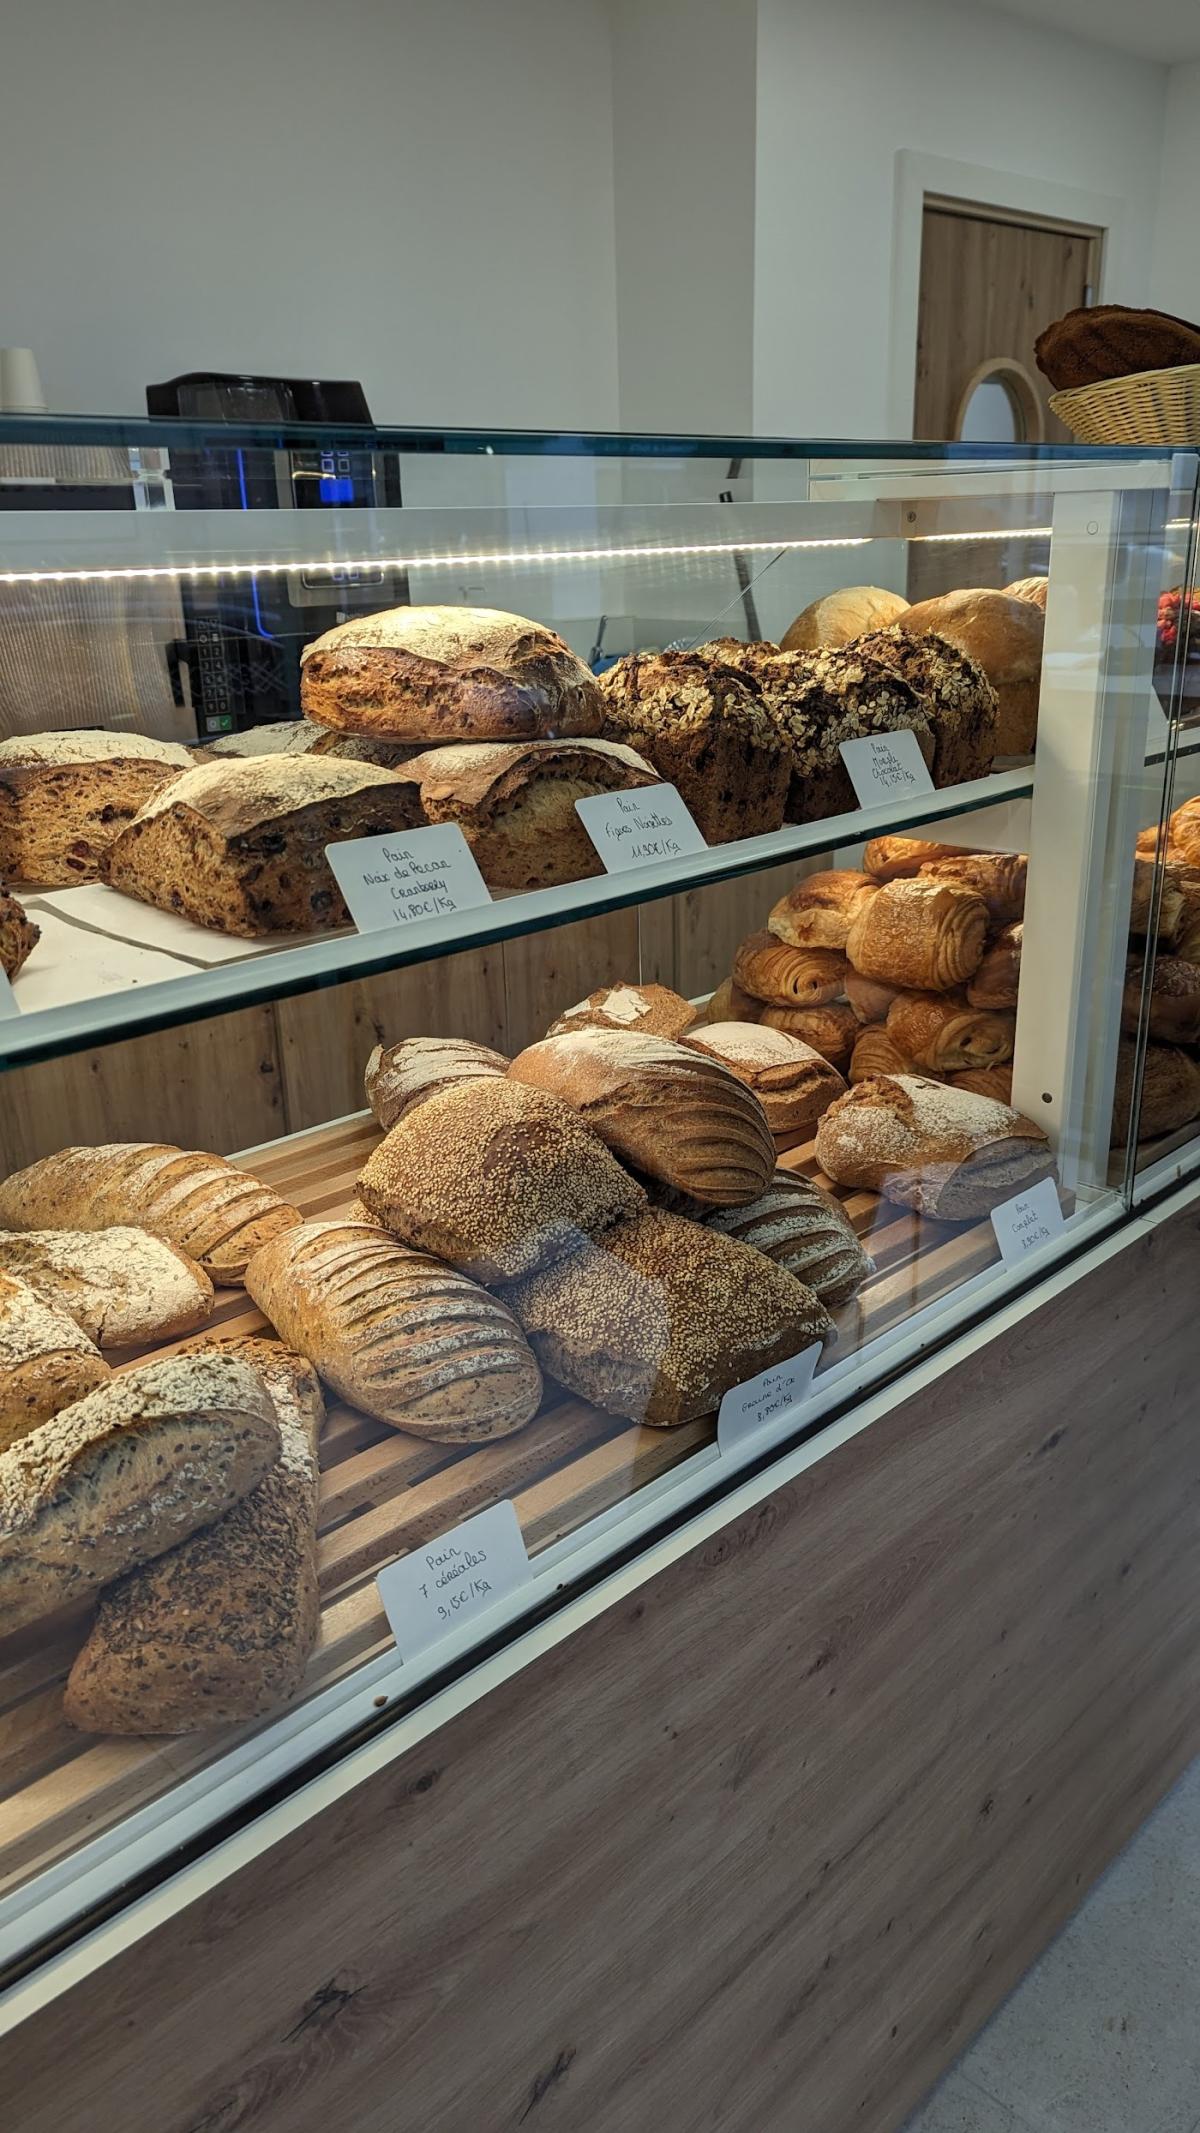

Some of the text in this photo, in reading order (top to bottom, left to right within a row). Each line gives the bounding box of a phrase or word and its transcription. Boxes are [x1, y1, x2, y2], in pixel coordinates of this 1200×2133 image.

[870, 742, 890, 754] Pain
[871, 762, 903, 779] Chocolat
[616, 797, 641, 814] Pain
[605, 822, 632, 841] Figues
[382, 847, 414, 863] Pain
[394, 865, 409, 879] de
[408, 859, 452, 874] Pecan
[390, 879, 448, 900] Cranberry
[1011, 1210, 1039, 1233] Complet
[763, 1375, 784, 1387] Pain
[425, 1547, 462, 1570] Pain
[418, 1550, 488, 1599] 7 céréales
[437, 1578, 493, 1620] 9,15€/Kg
